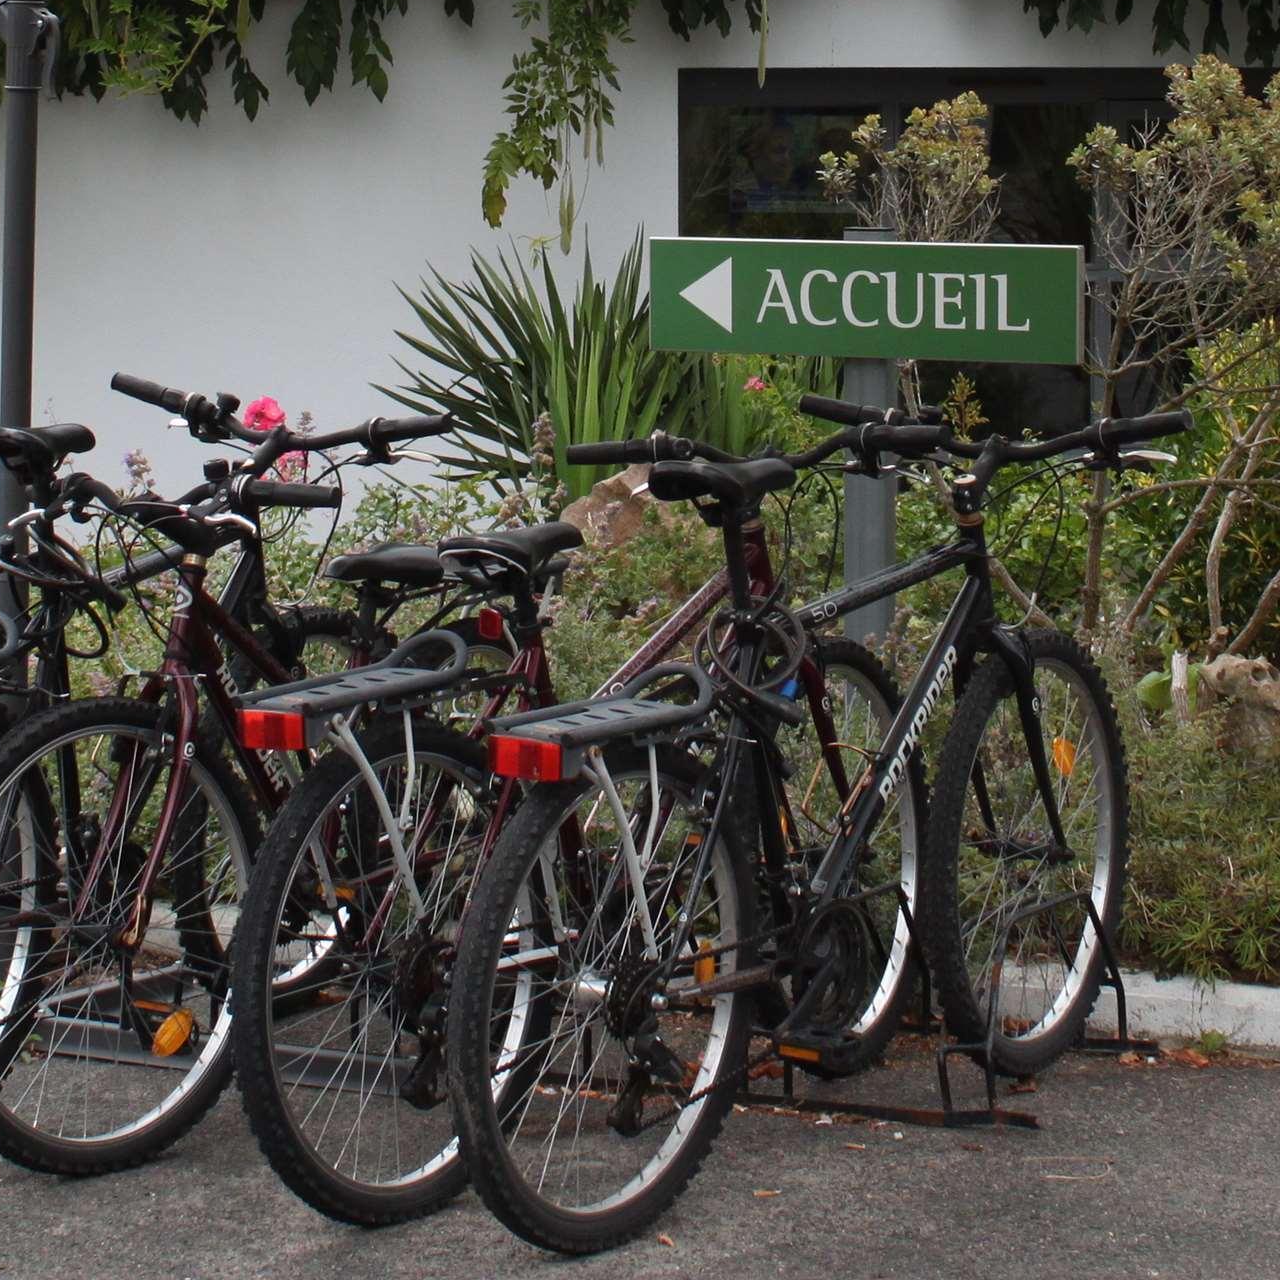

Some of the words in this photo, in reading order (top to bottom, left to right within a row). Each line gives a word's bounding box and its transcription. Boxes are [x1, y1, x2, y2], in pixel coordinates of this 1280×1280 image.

[755, 268, 1031, 333] ACCUEIL
[810, 600, 839, 624] 50
[878, 644, 959, 803] ROCKRIDER
